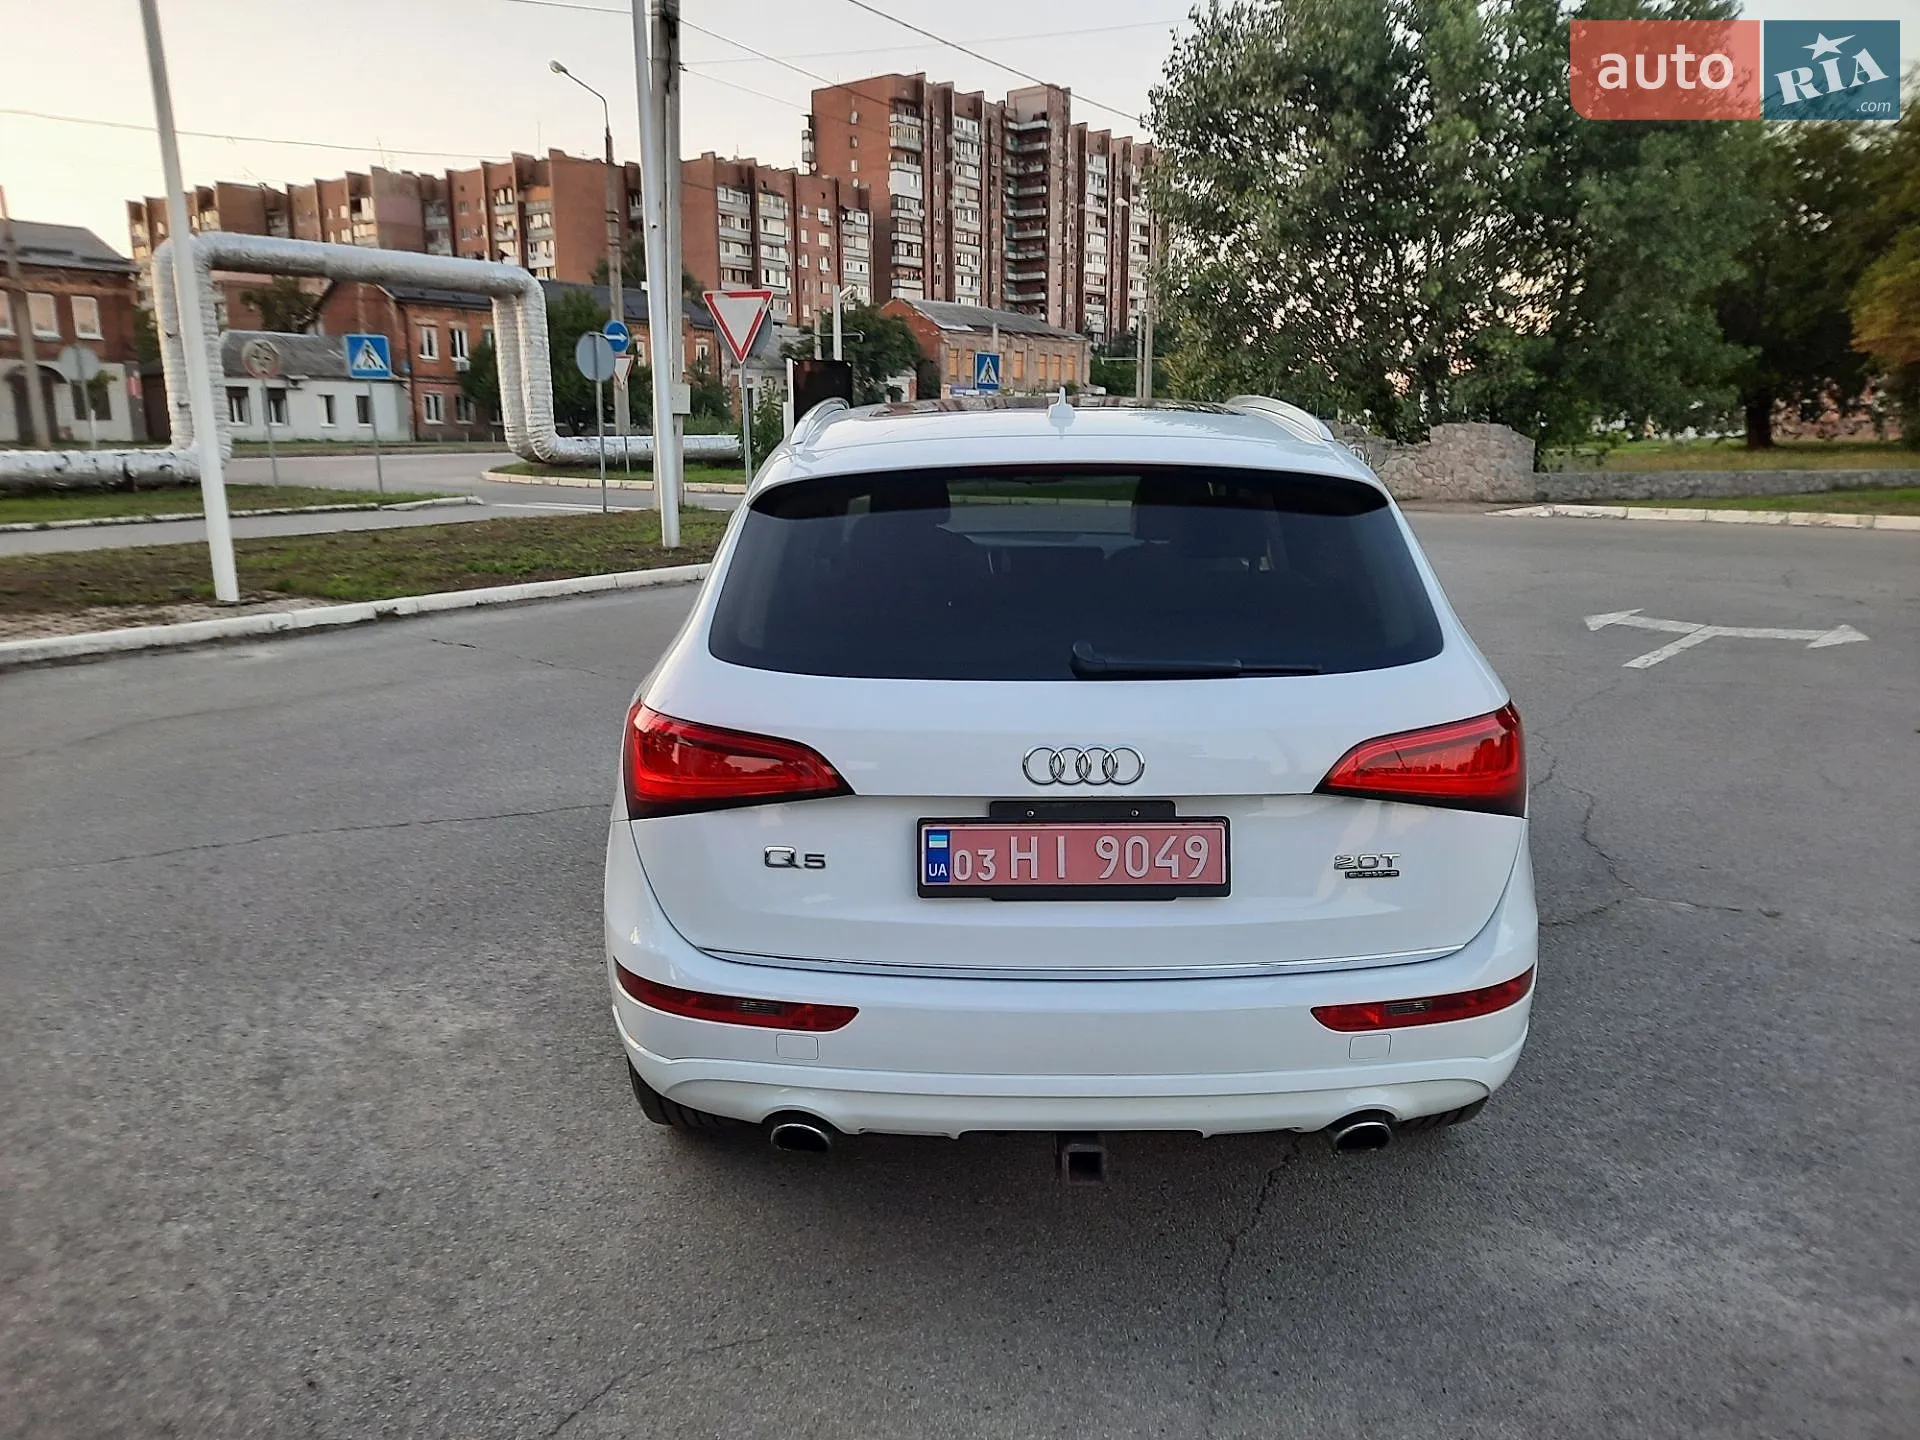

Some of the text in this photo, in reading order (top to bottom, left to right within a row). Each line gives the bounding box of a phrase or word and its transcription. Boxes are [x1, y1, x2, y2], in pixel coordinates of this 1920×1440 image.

[764, 845, 826, 869] Q5
[953, 848, 997, 881] 03
[1095, 835, 1210, 879] 9049
[928, 862, 947, 877] UA
